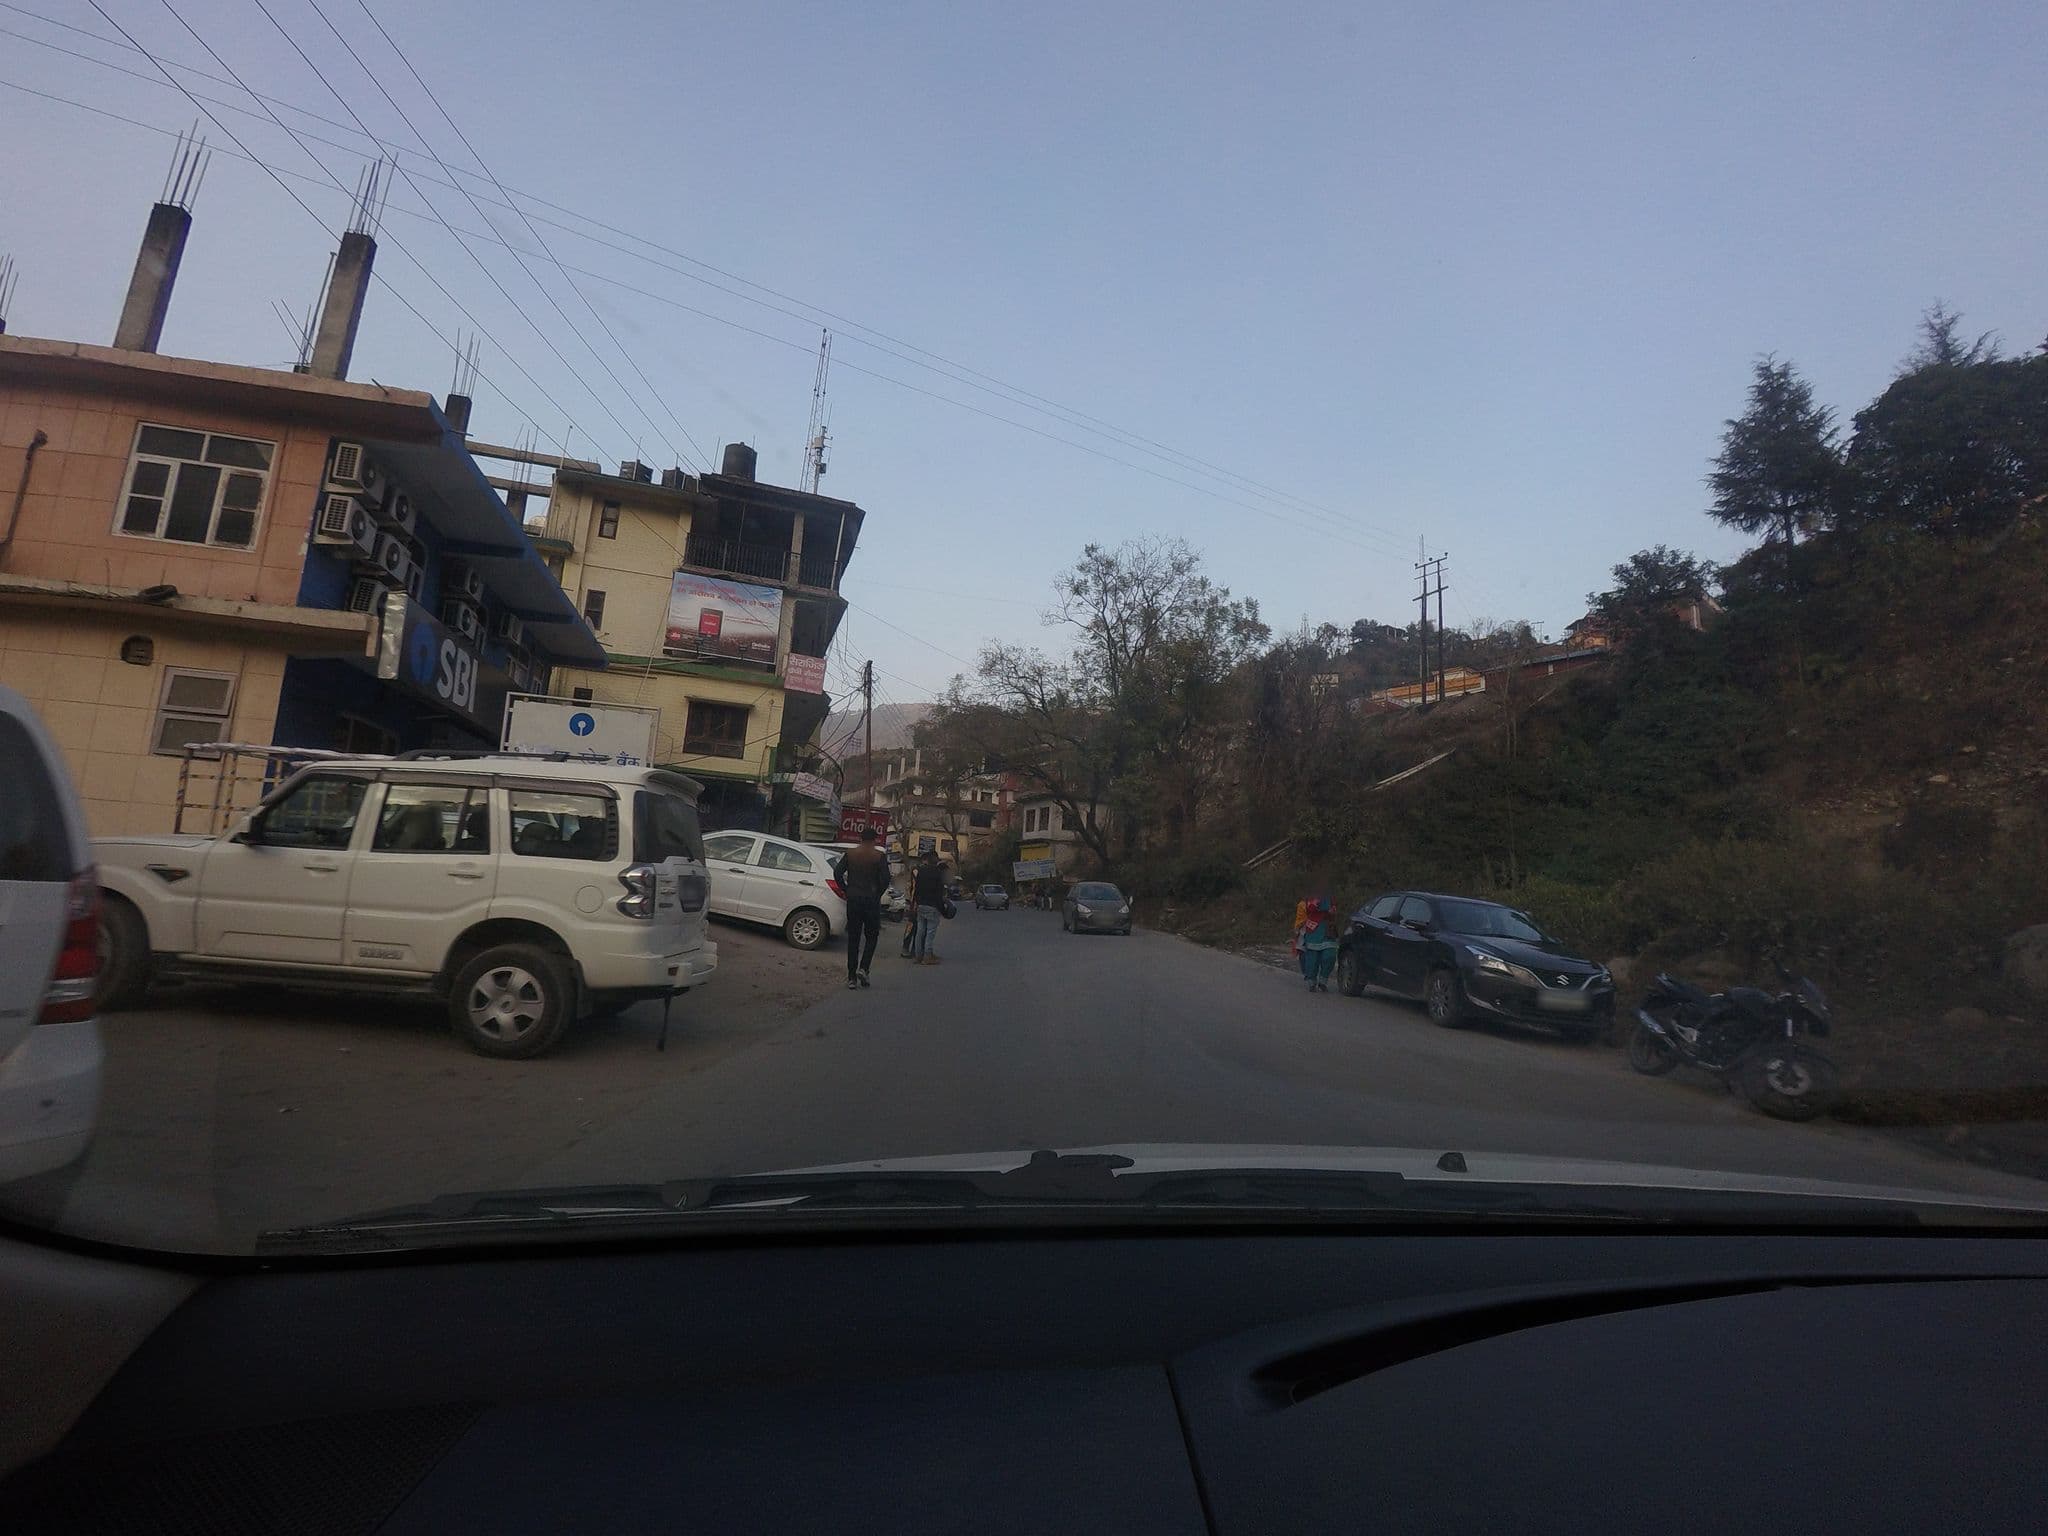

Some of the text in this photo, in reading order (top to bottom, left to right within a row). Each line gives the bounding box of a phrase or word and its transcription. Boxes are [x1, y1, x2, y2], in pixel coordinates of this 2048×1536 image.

[437, 638, 479, 713] SBI
[615, 750, 641, 767] बैंक
[841, 817, 885, 836] Chala
